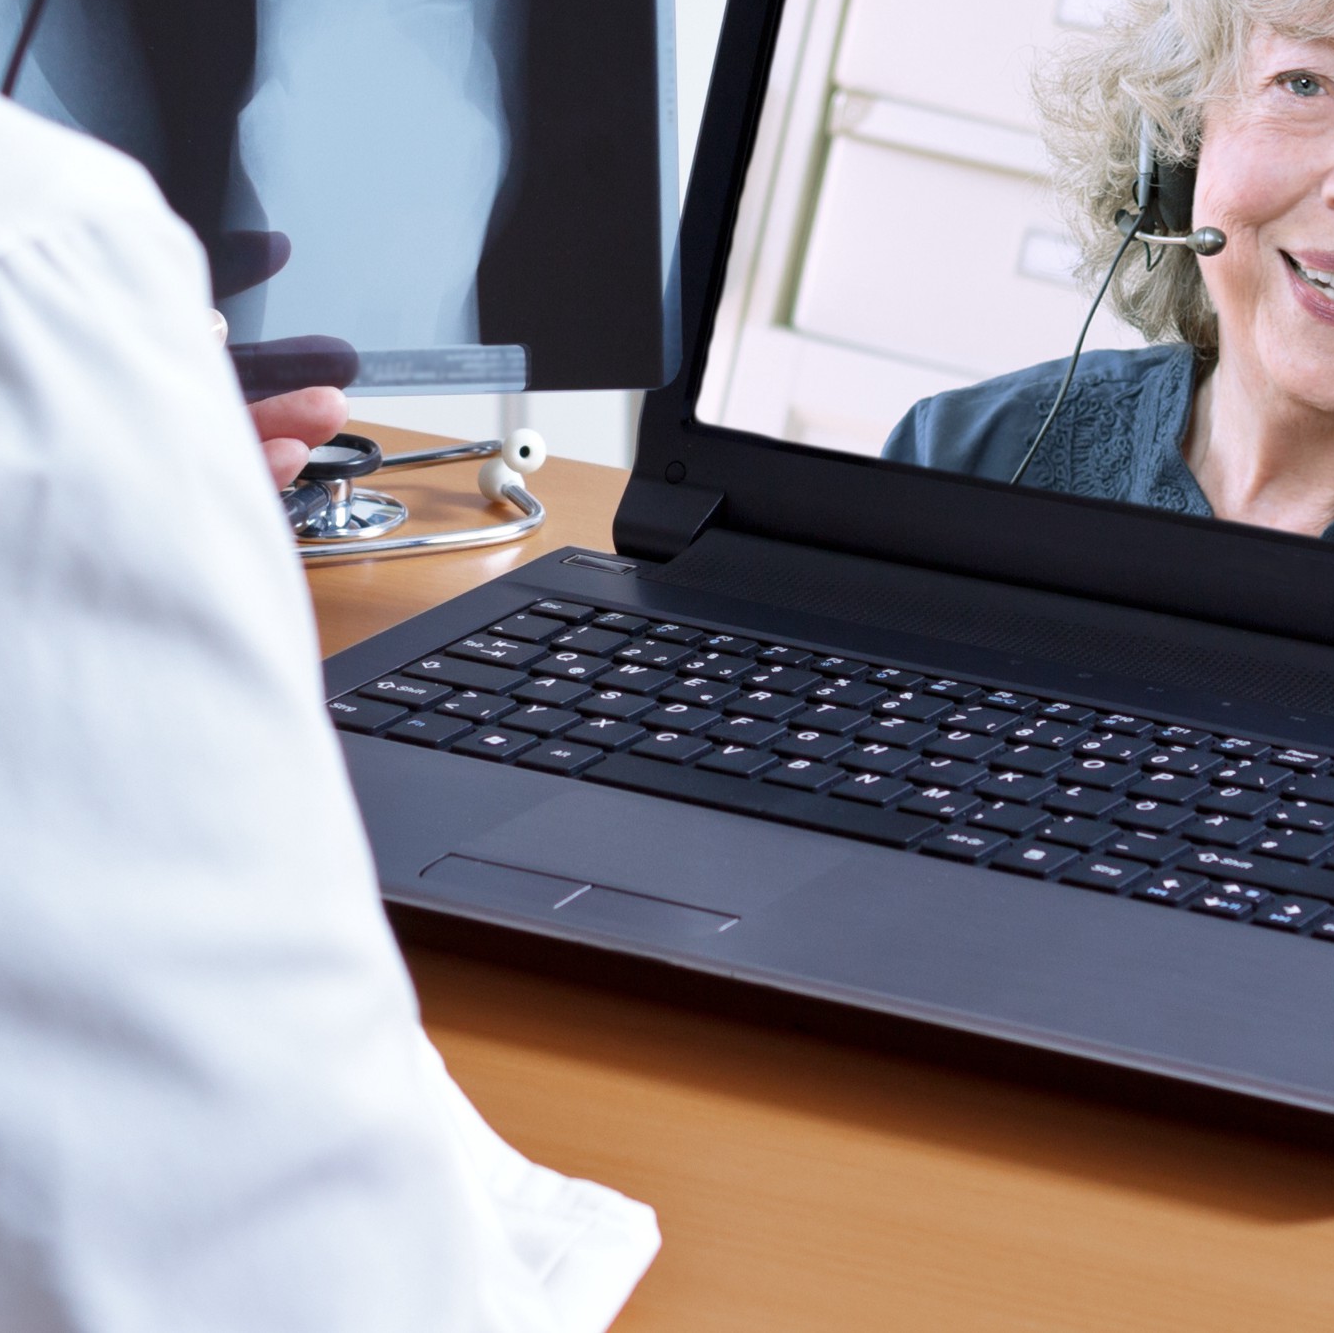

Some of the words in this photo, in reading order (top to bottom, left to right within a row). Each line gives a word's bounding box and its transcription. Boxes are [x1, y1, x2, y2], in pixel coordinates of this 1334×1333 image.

[556, 653, 577, 661] Q
[619, 665, 647, 674] W
[684, 678, 707, 686] E
[397, 686, 426, 694] Shift
[749, 692, 771, 700] R
[329, 703, 357, 712] Strg
[527, 705, 547, 713] Y
[590, 719, 615, 728] X
[880, 718, 905, 727] Z
[1167, 726, 1191, 734] F11
[656, 733, 678, 741] C
[797, 732, 819, 740] G
[948, 732, 971, 740] U
[723, 746, 744, 754] V
[863, 745, 888, 754] H
[788, 760, 810, 769] B
[1083, 760, 1105, 768] O
[855, 774, 880, 783] N
[998, 773, 1023, 782] K
[922, 788, 950, 798] M
[1066, 787, 1081, 796] L
[1220, 788, 1241, 796] Ü
[1136, 801, 1157, 810] Ö
[1219, 857, 1254, 869] Shift
